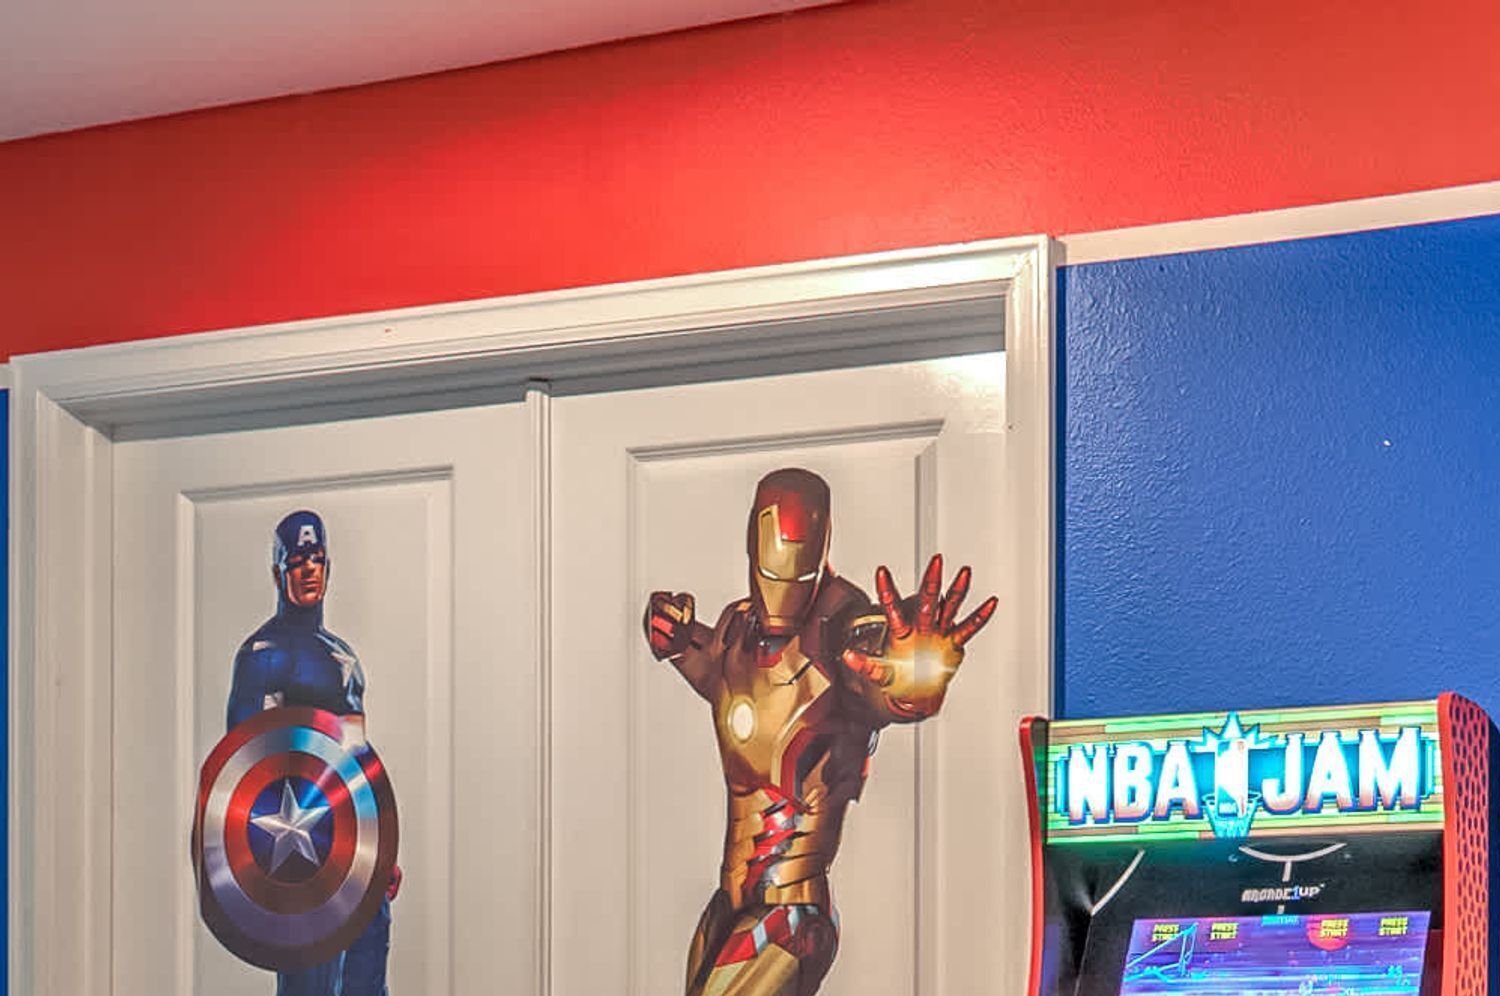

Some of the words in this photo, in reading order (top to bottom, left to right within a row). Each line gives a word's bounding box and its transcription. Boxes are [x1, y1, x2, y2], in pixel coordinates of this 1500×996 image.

[298, 525, 317, 546] A
[1067, 740, 1204, 825] NBA
[1260, 726, 1425, 815] JAM
